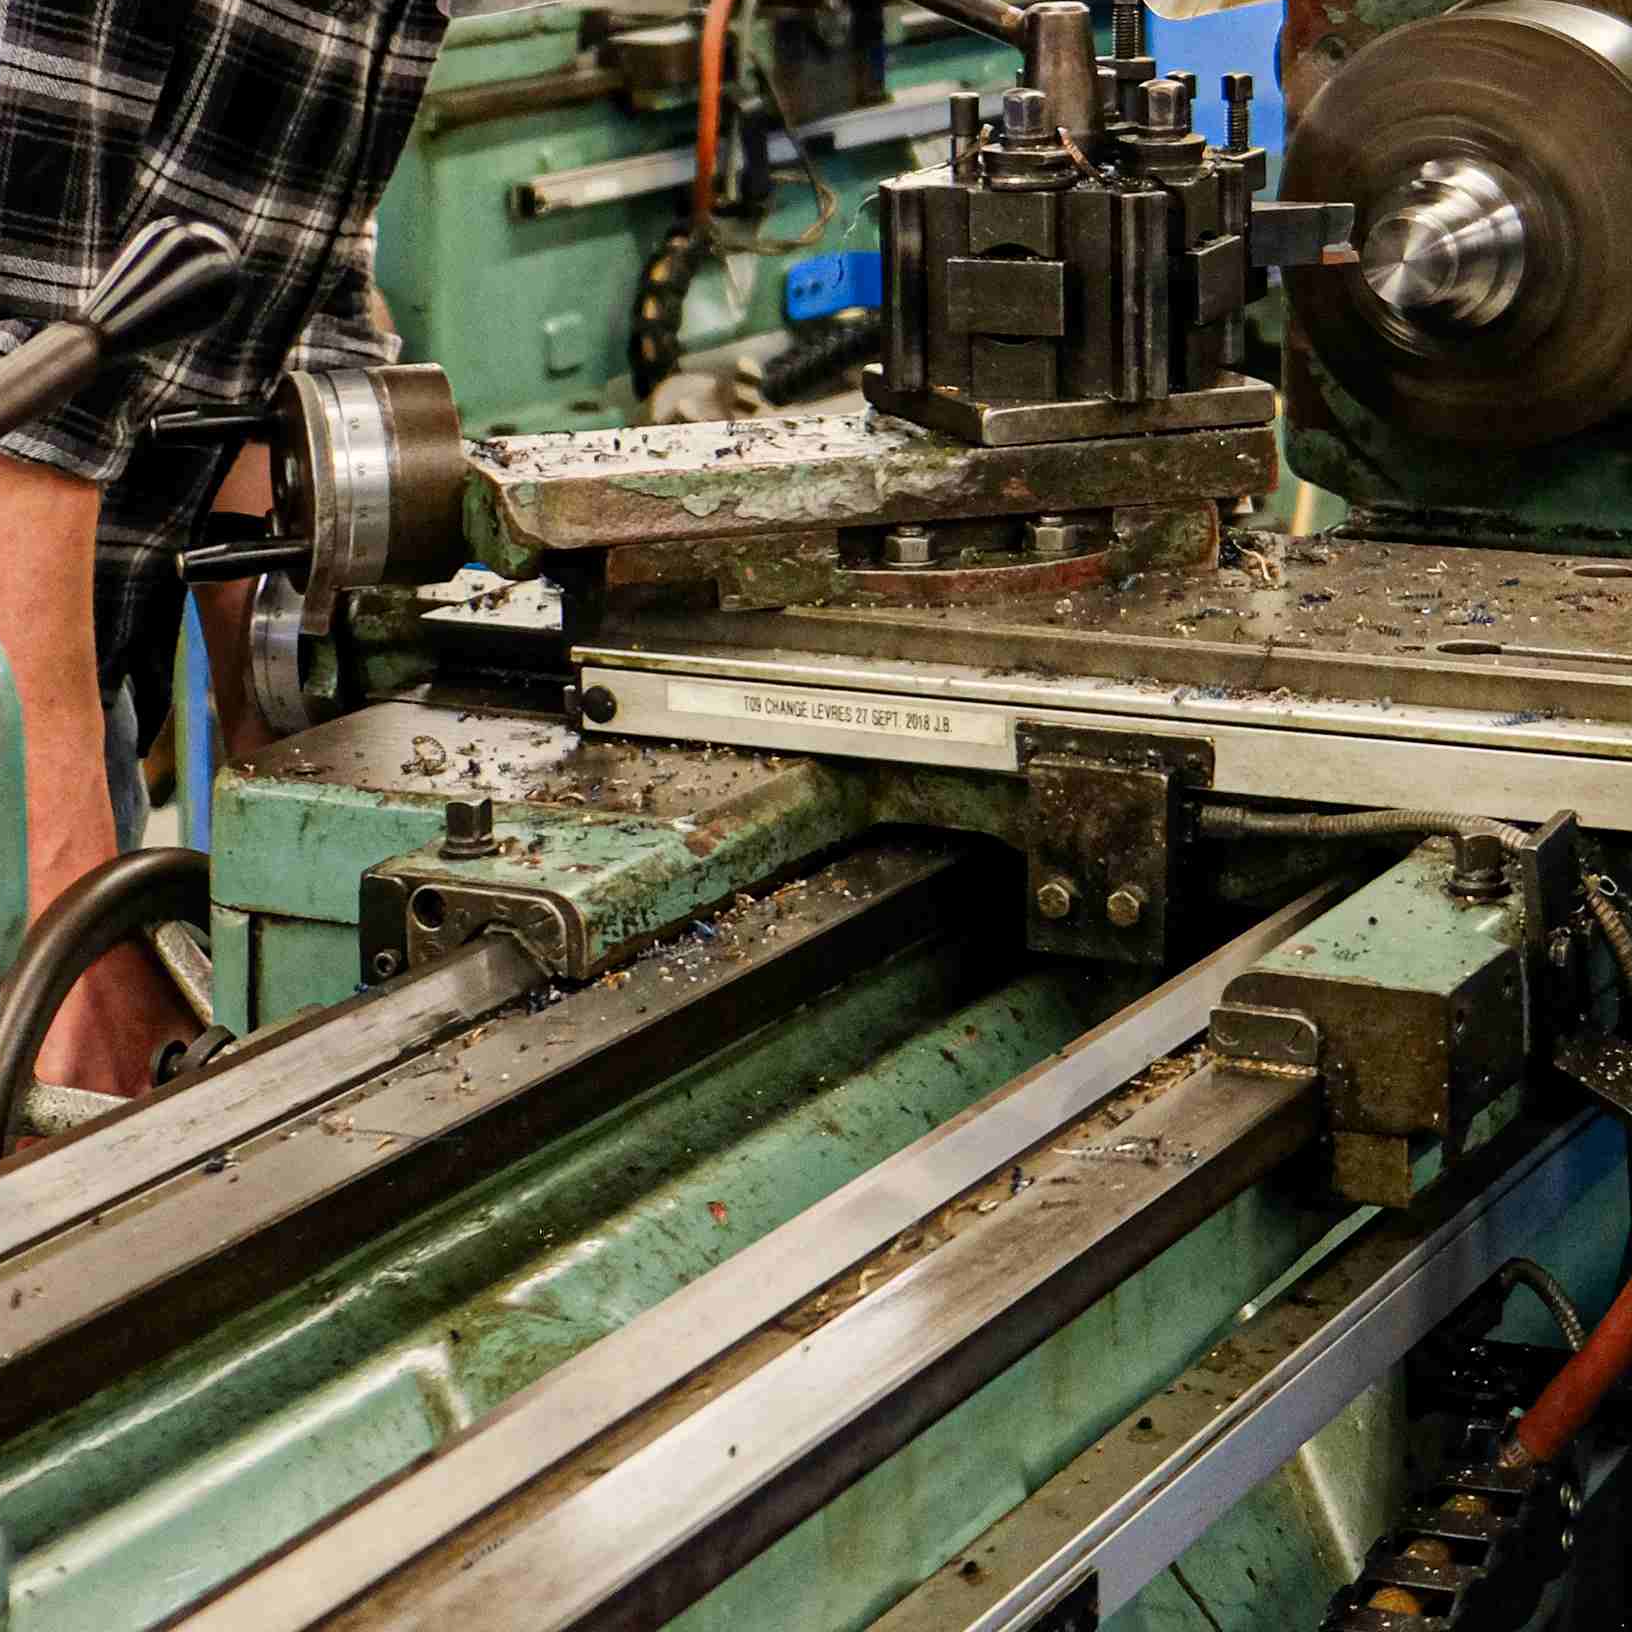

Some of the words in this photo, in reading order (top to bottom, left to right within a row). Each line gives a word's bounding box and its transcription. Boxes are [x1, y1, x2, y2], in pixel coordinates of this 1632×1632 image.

[764, 697, 809, 718] CHANGE
[811, 702, 853, 723] LEVRES
[855, 706, 869, 724] 27
[905, 712, 931, 731] 2018
